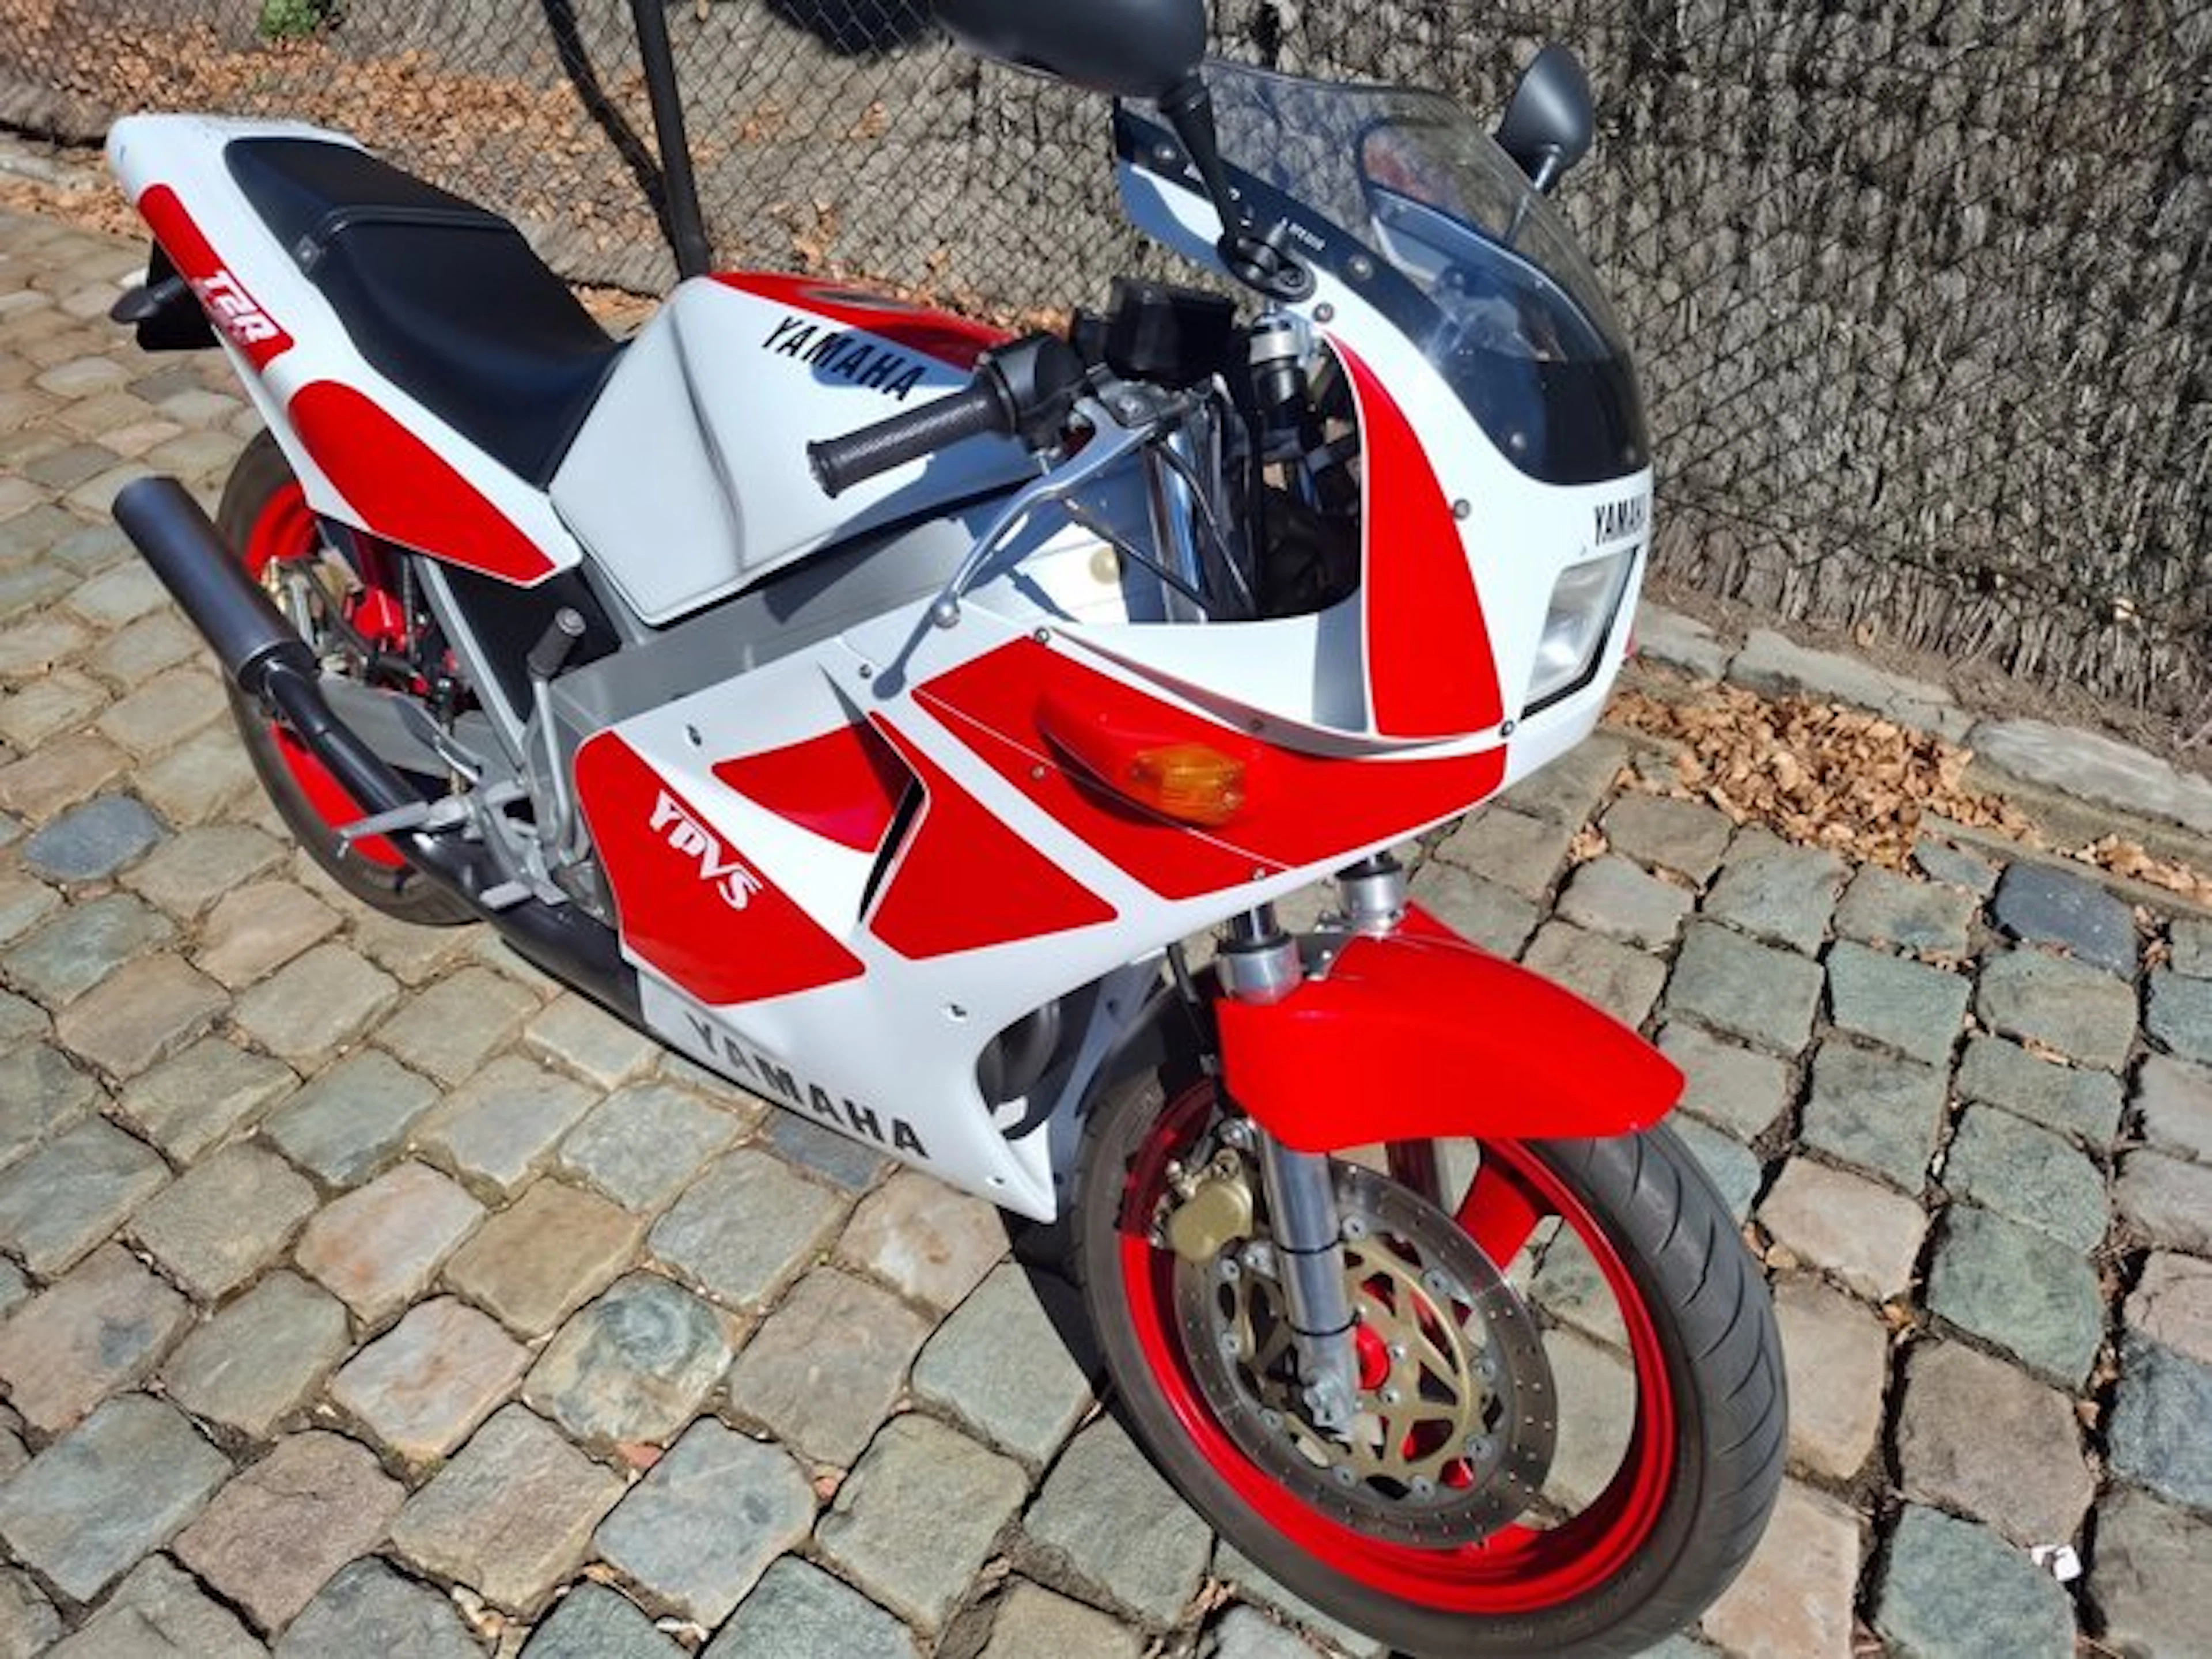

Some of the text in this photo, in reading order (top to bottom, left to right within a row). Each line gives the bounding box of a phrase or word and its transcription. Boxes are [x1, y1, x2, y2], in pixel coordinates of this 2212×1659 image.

[762, 316, 925, 401] YAMAHA
[649, 789, 763, 911] YPVS
[684, 1011, 931, 1159] YAMAHA
